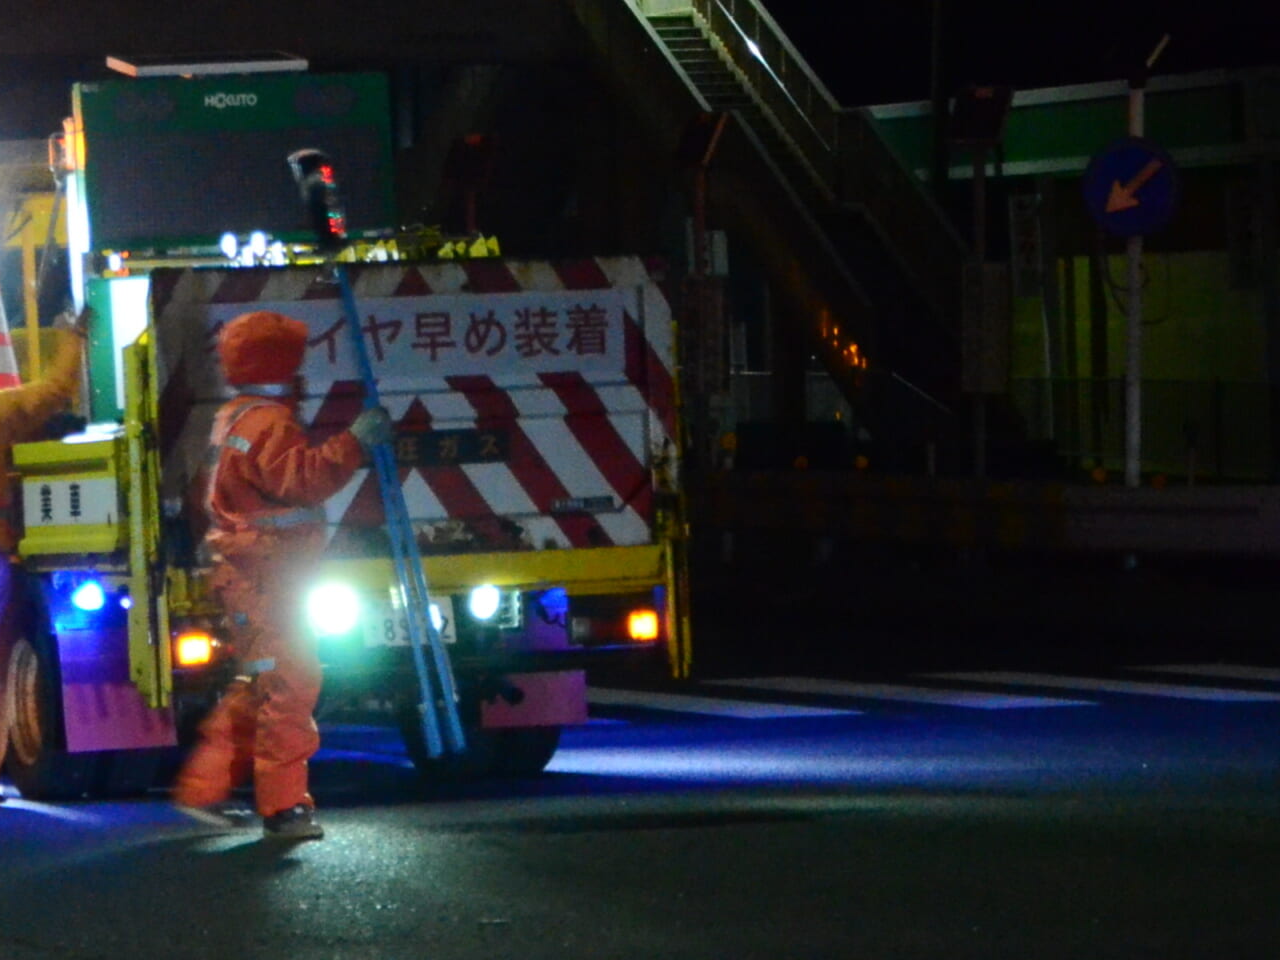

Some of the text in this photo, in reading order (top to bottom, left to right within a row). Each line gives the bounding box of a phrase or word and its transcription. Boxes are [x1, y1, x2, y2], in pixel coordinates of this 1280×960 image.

[204, 92, 258, 109] HOKUTO
[206, 304, 609, 365] イヤ早め装着
[397, 435, 500, 460] 圧ガス
